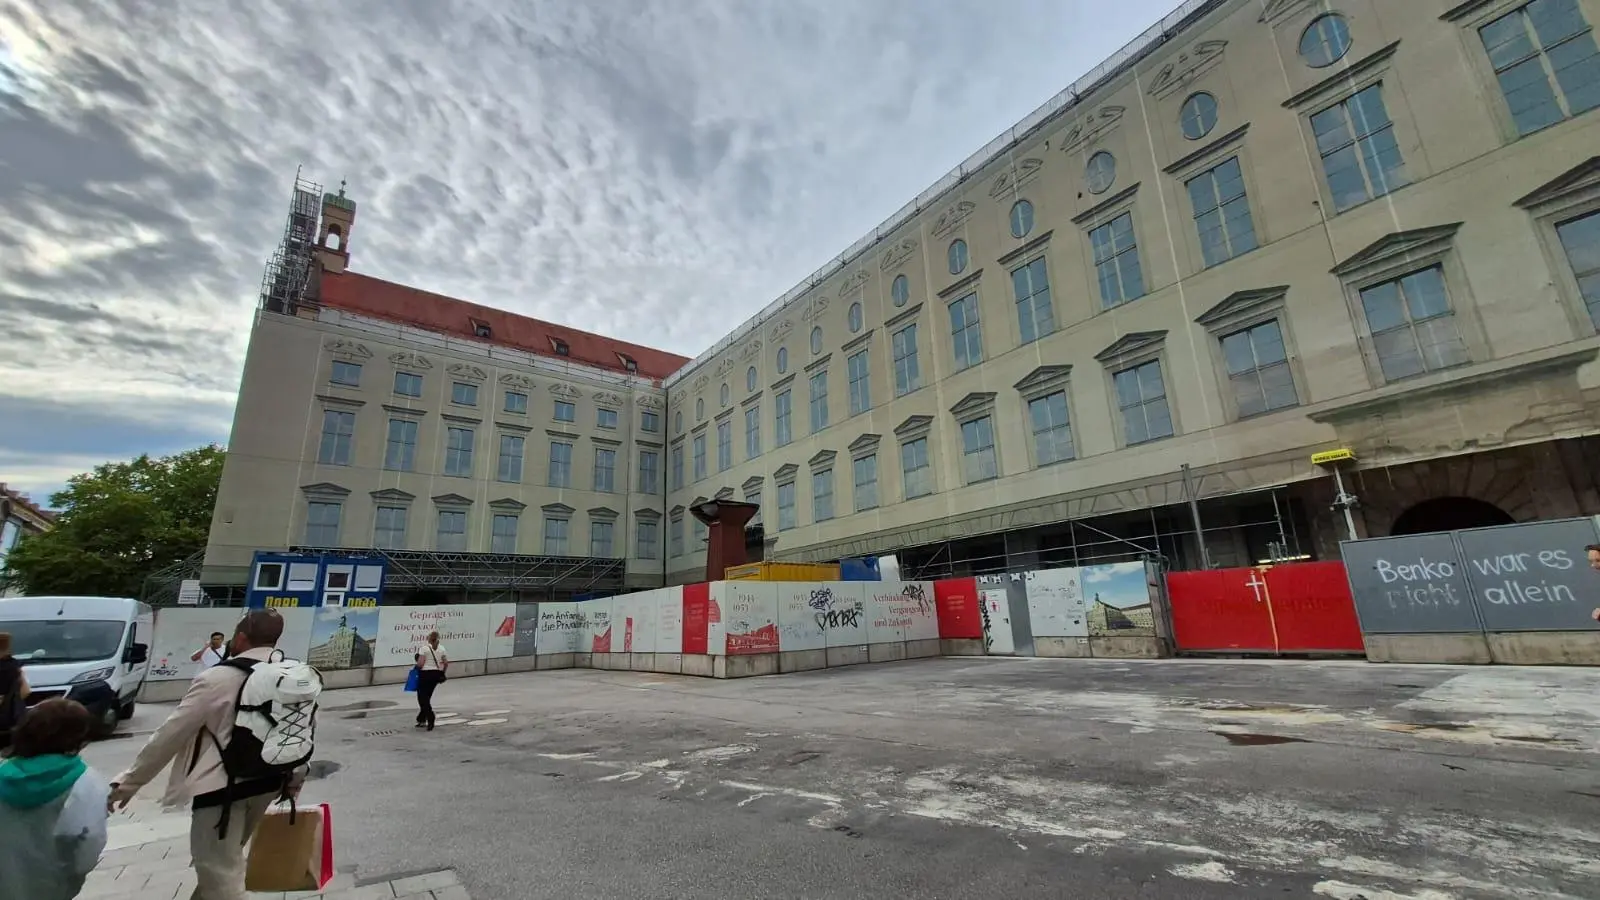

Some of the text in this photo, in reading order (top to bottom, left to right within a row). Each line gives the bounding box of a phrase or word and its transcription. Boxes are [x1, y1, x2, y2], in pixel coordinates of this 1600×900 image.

[1376, 549, 1575, 584] Benko war es
[1484, 580, 1577, 605] allein
